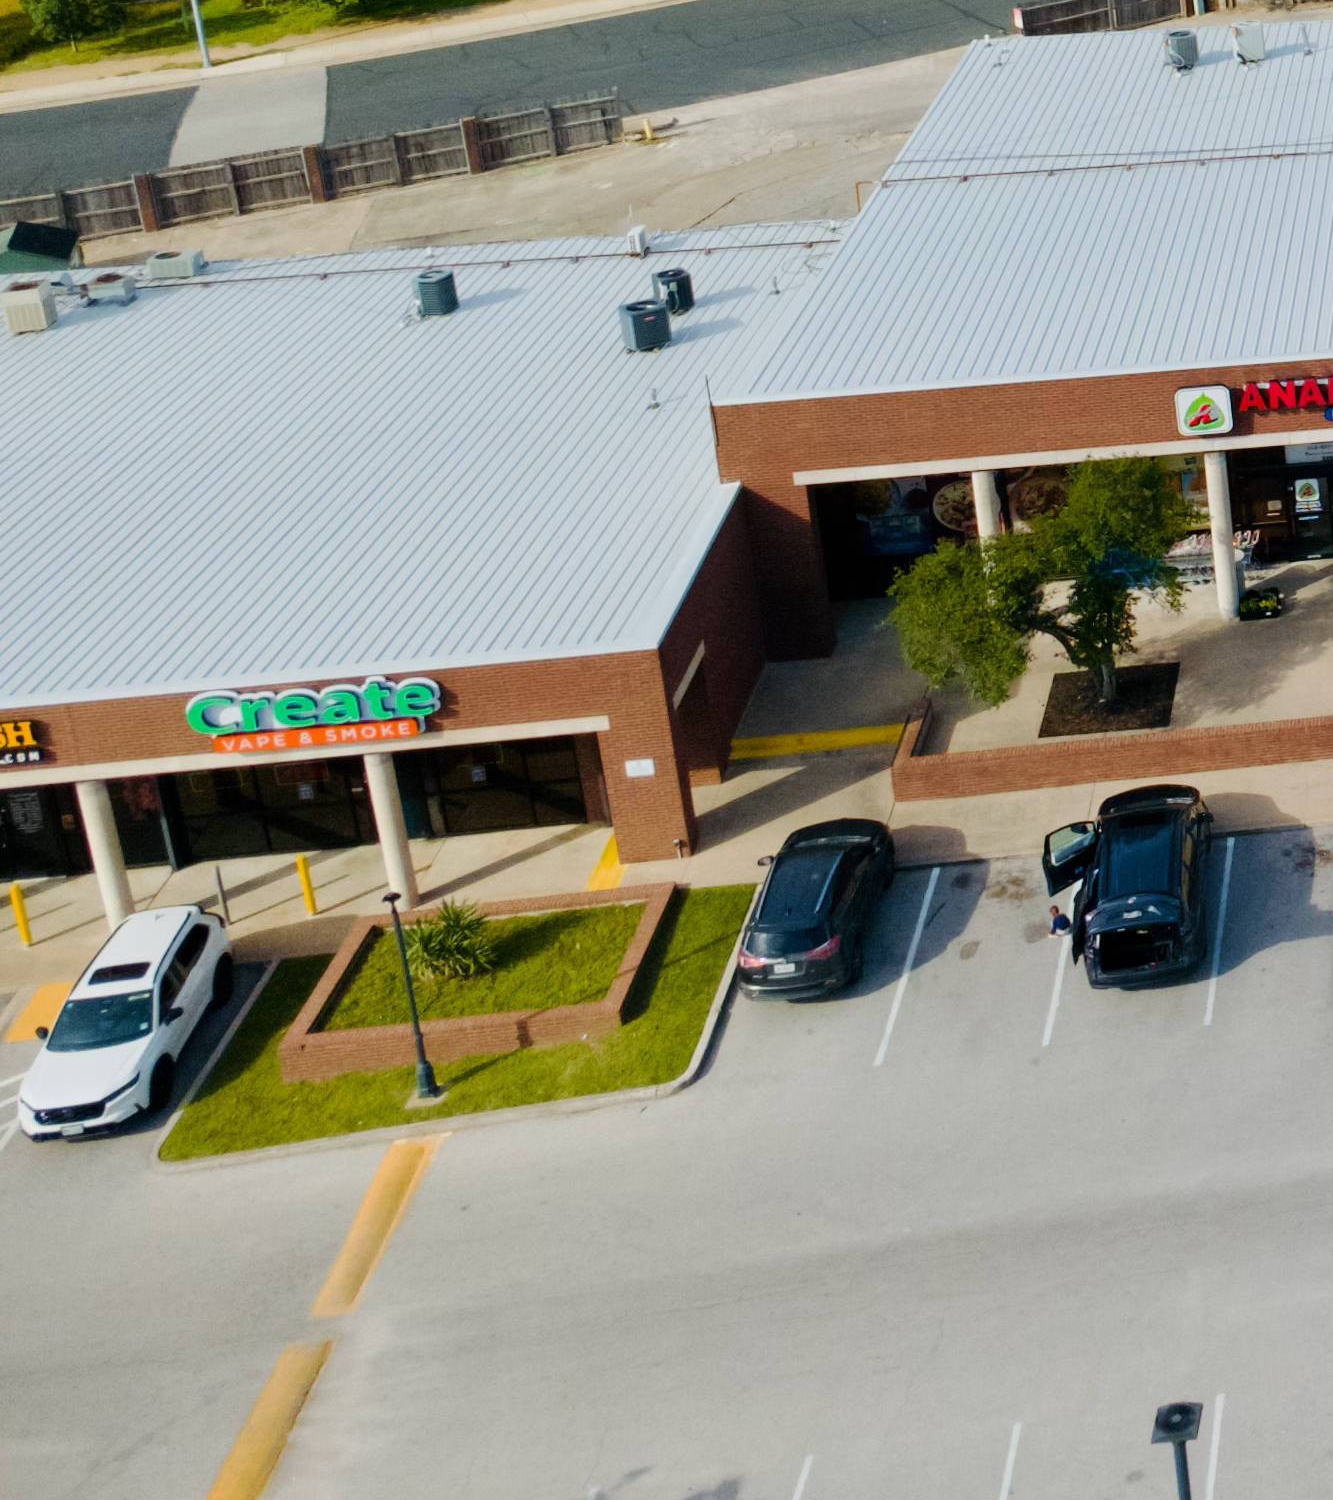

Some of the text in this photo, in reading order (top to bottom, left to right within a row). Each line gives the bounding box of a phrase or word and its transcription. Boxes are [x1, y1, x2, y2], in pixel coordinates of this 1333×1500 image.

[186, 681, 435, 735] Create
[221, 722, 411, 751] VAPE & SMOKE
